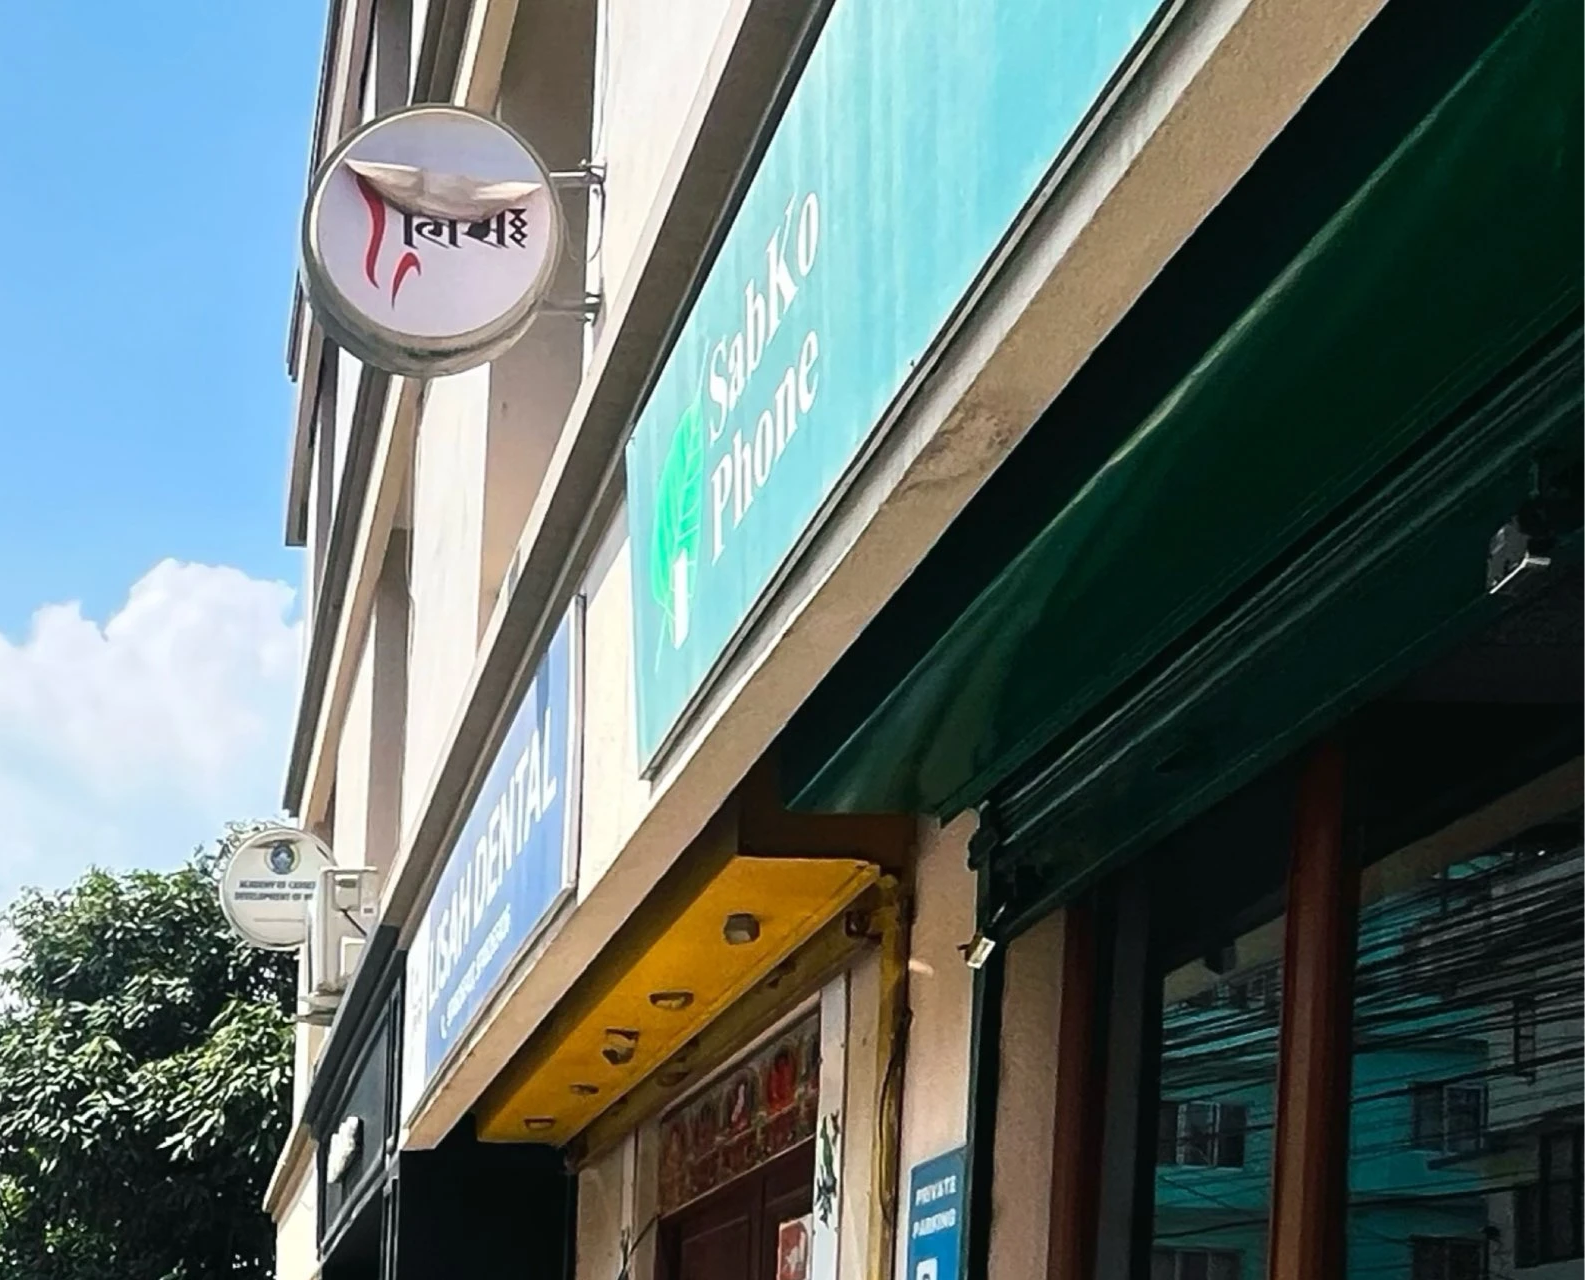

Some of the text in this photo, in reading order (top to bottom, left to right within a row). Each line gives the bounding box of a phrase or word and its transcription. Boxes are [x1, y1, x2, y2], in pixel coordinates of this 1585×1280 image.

[709, 190, 819, 448] SabKo
[711, 331, 818, 566] Phone
[474, 707, 557, 929] DENTAL
[912, 1208, 957, 1239] PARKING
[915, 1175, 957, 1207] PRIVATE
